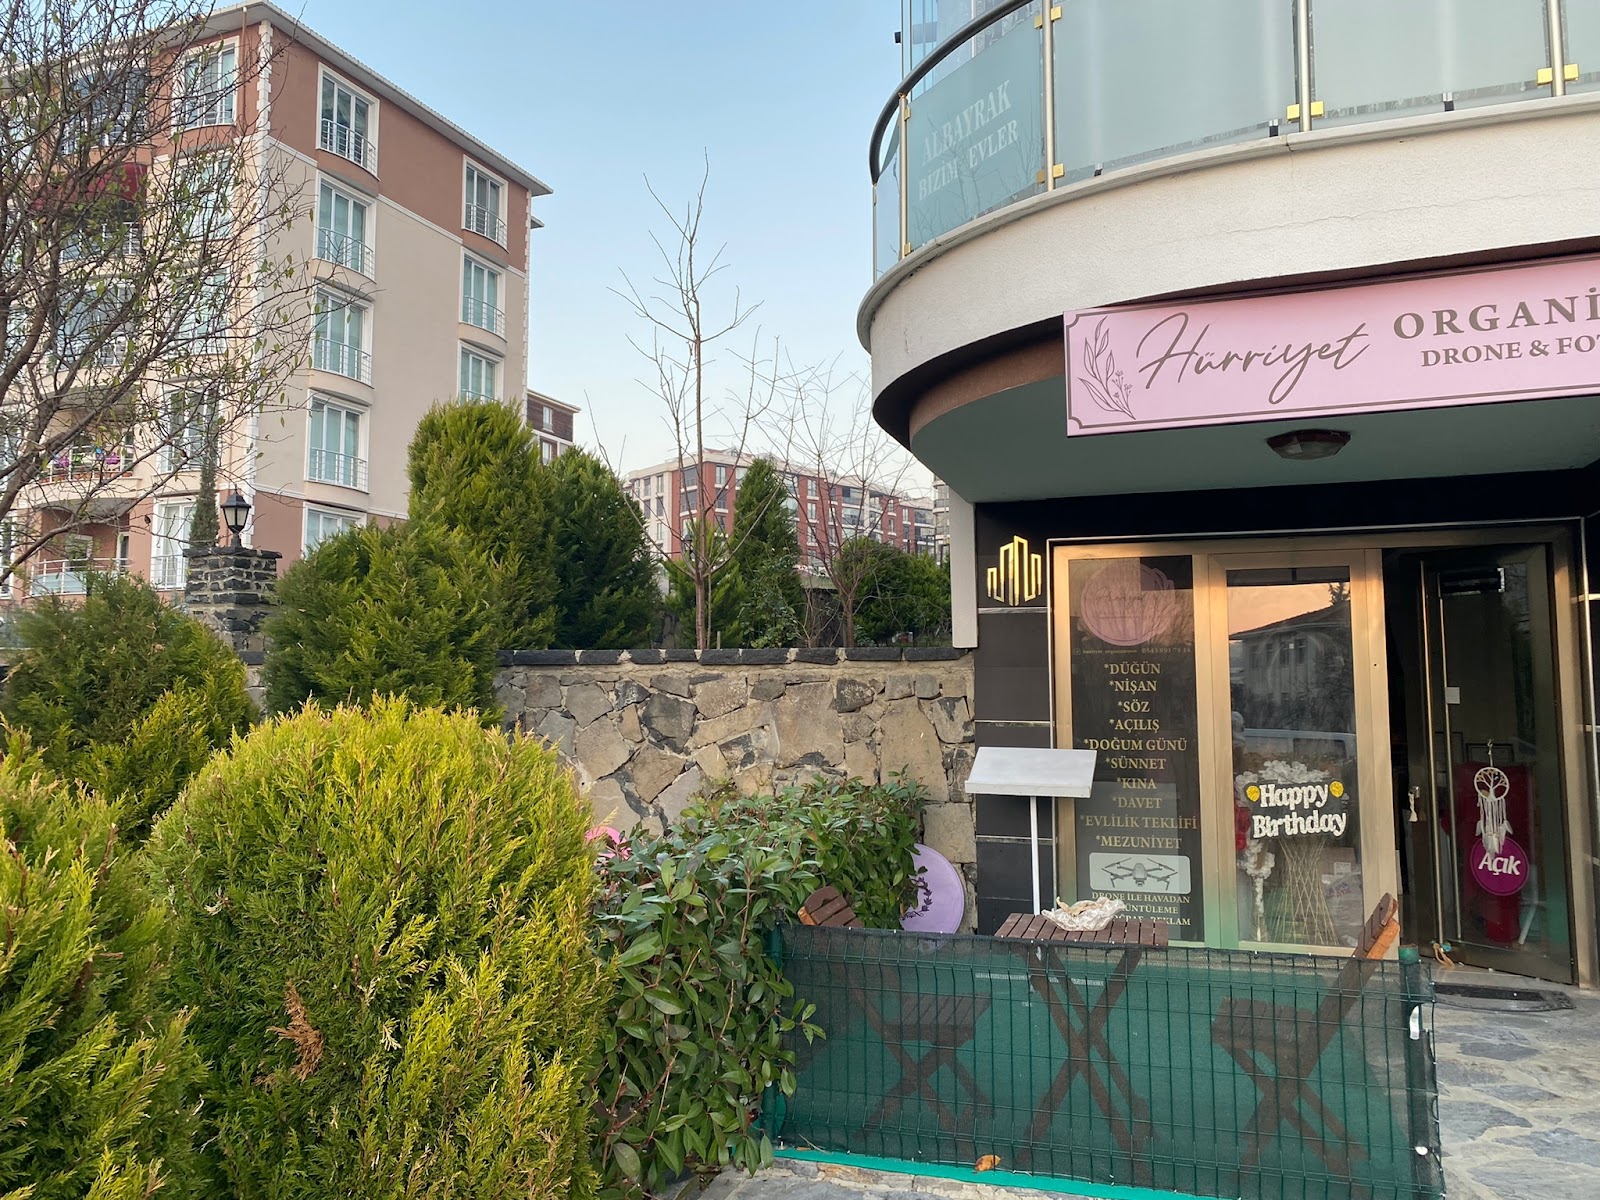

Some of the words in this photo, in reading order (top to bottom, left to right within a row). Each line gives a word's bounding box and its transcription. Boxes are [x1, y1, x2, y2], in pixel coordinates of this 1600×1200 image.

[922, 79, 1012, 167] ALBAYRAK
[968, 119, 1019, 169] EVLER
[1136, 311, 1371, 405] Hürriyet
[1421, 341, 1523, 367] DRONE
[1529, 339, 1550, 357] &
[1556, 334, 1600, 354] FO
[1146, 737, 1188, 751] GÜNÜ
[1259, 783, 1329, 811] Happy
[1142, 815, 1198, 830] TEKLİFİ
[1251, 809, 1347, 839] Birthday
[1477, 851, 1522, 876] Açık
[1121, 902, 1179, 914] ÜNTÜLEME
[1127, 891, 1143, 902] İLE
[1144, 893, 1190, 904] HAVADAN
